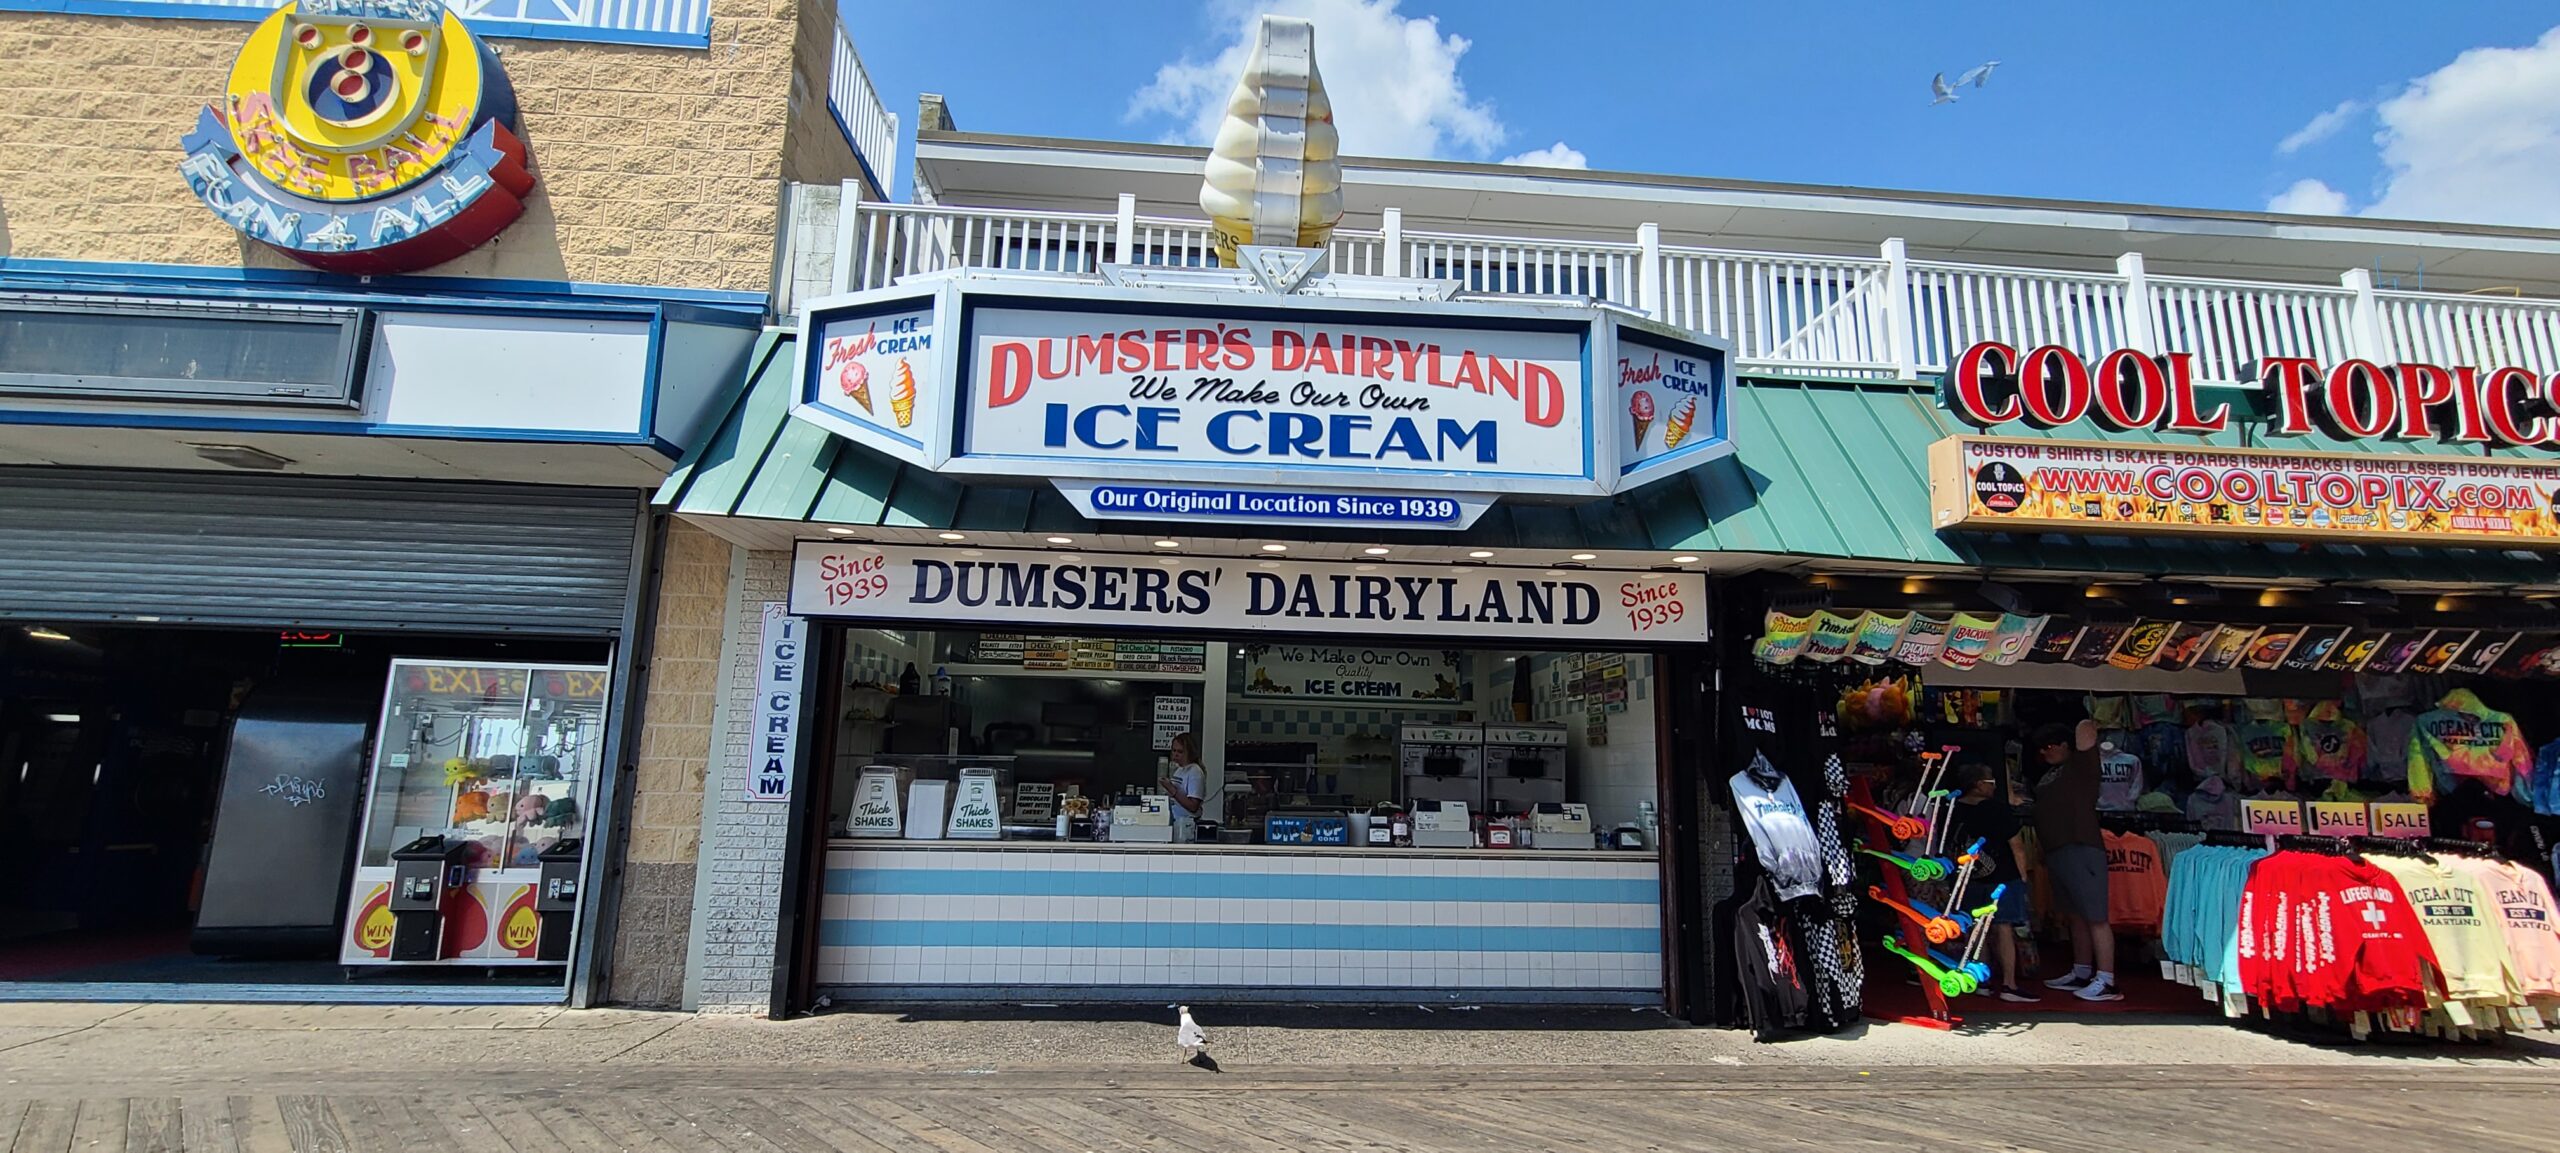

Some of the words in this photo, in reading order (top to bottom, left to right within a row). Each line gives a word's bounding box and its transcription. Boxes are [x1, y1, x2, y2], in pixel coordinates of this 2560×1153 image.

[345, 102, 469, 194] BALL
[180, 152, 301, 247] FUN
[304, 215, 357, 250] 4
[370, 173, 490, 243] ALL
[892, 317, 919, 334] ICE
[825, 321, 876, 371] Fresh
[877, 334, 931, 355] CREAM
[988, 323, 1255, 409] DUMSER'S
[1271, 329, 1565, 428] DAIRYLAND
[1618, 352, 1662, 388] Fresh
[1673, 358, 1697, 378] ICE
[1129, 375, 1177, 401] We
[1186, 377, 1280, 405] Make
[1289, 381, 1350, 409] Our
[1359, 384, 1431, 411] Own
[1662, 375, 1708, 398] CREAM
[1952, 340, 2231, 433] COOL
[1044, 403, 1181, 452] ICE
[1205, 409, 1499, 464] CREAM
[1971, 443, 2040, 459] CUSTOM
[2047, 447, 2103, 462] SHIRTS
[2115, 450, 2167, 465] SKATE
[2174, 453, 2238, 468] BOARDS
[2250, 457, 2343, 472] SNAPBACKS
[2354, 460, 2457, 476] SUNGLASSES
[2468, 466, 2509, 478] BODY
[1976, 482, 1997, 491] COOL
[1097, 489, 1139, 507] Our
[1143, 489, 1232, 512] Original
[1238, 492, 1331, 514] Location
[1336, 497, 1396, 516] Since
[1400, 499, 1454, 518] 1939
[2146, 500, 2168, 521] 47
[820, 554, 886, 582] Since
[824, 574, 889, 607] 1939
[908, 558, 1223, 615] DUMSERS'
[1244, 571, 1602, 626] DAIRYLAND
[1620, 581, 1679, 608] Since
[1627, 600, 1685, 632] 1939
[773, 620, 796, 681] ICE
[1279, 647, 1304, 662] We
[1310, 647, 1356, 663] Make
[1361, 650, 1392, 665] Our
[1396, 651, 1431, 666] Own
[1305, 679, 1335, 694] ICE
[1341, 681, 1401, 697] CREAM
[2430, 719, 2476, 737] OCEAN
[758, 692, 791, 794] CREAM
[860, 801, 891, 816] Thick
[961, 802, 991, 817] Thick
[2254, 810, 2298, 825] SALE
[2320, 812, 2364, 826] SALE
[855, 817, 893, 827] SHAKES
[956, 819, 993, 828] SHAKES
[2384, 813, 2427, 828] SALE
[367, 925, 393, 937] WIN
[510, 925, 535, 938] WIN
